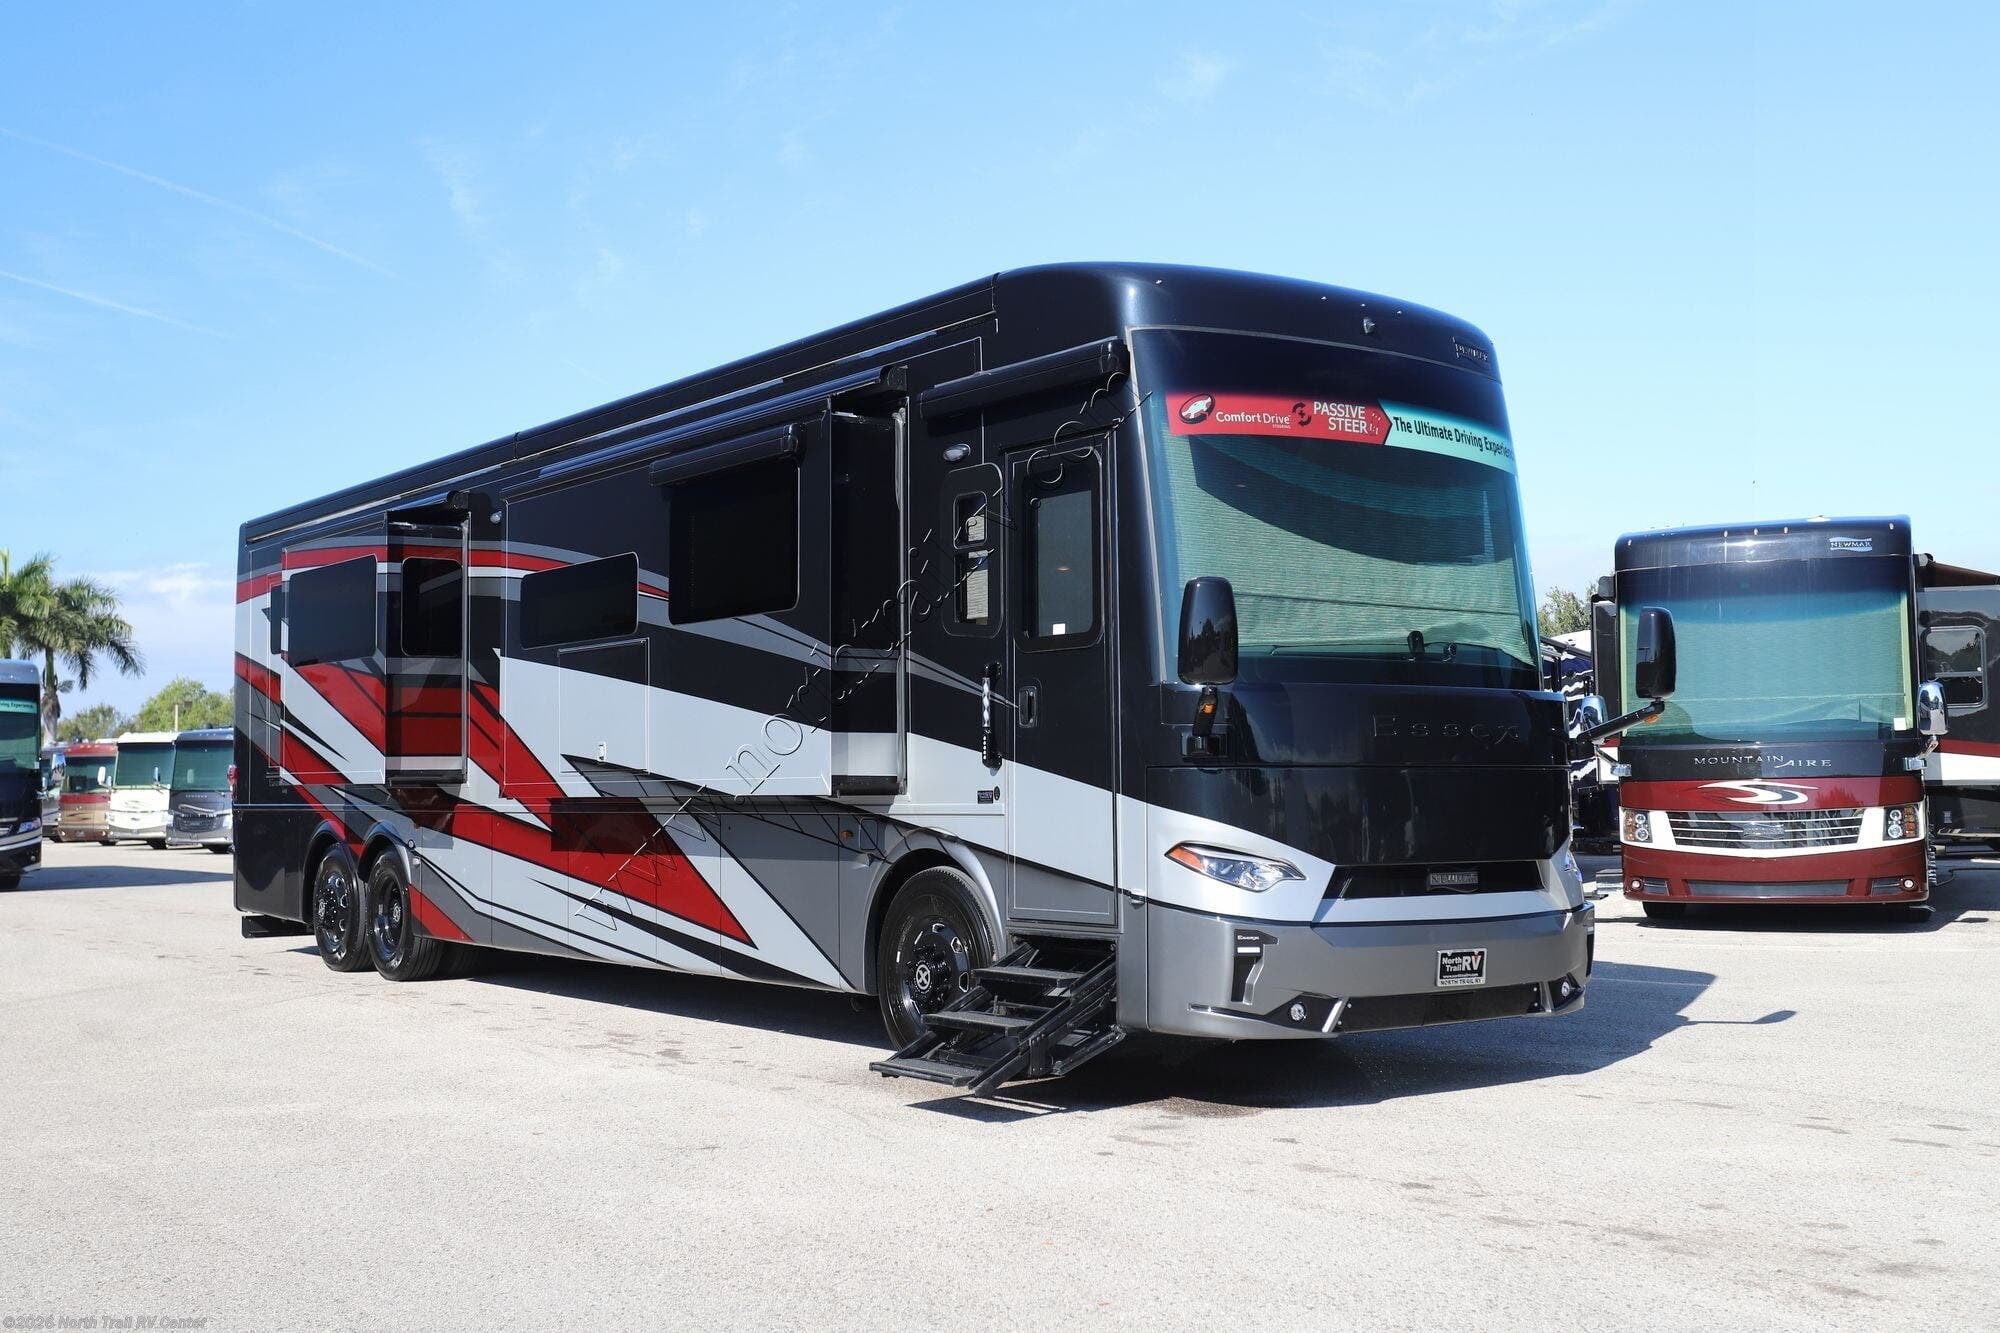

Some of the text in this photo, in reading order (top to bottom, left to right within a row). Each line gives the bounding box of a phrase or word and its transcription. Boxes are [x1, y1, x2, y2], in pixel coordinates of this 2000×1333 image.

[1215, 411, 1262, 423] Comfort
[1313, 402, 1366, 419] PASSIVE
[1328, 418, 1369, 434] STEER
[1393, 416, 1413, 433] The
[1414, 420, 1453, 442] Ultimate
[1455, 428, 1484, 452] Driving
[1694, 755, 1832, 769] MOUNTAIN AIRE
[1442, 956, 1462, 965] North
[1446, 955, 1482, 972] Trail RV
